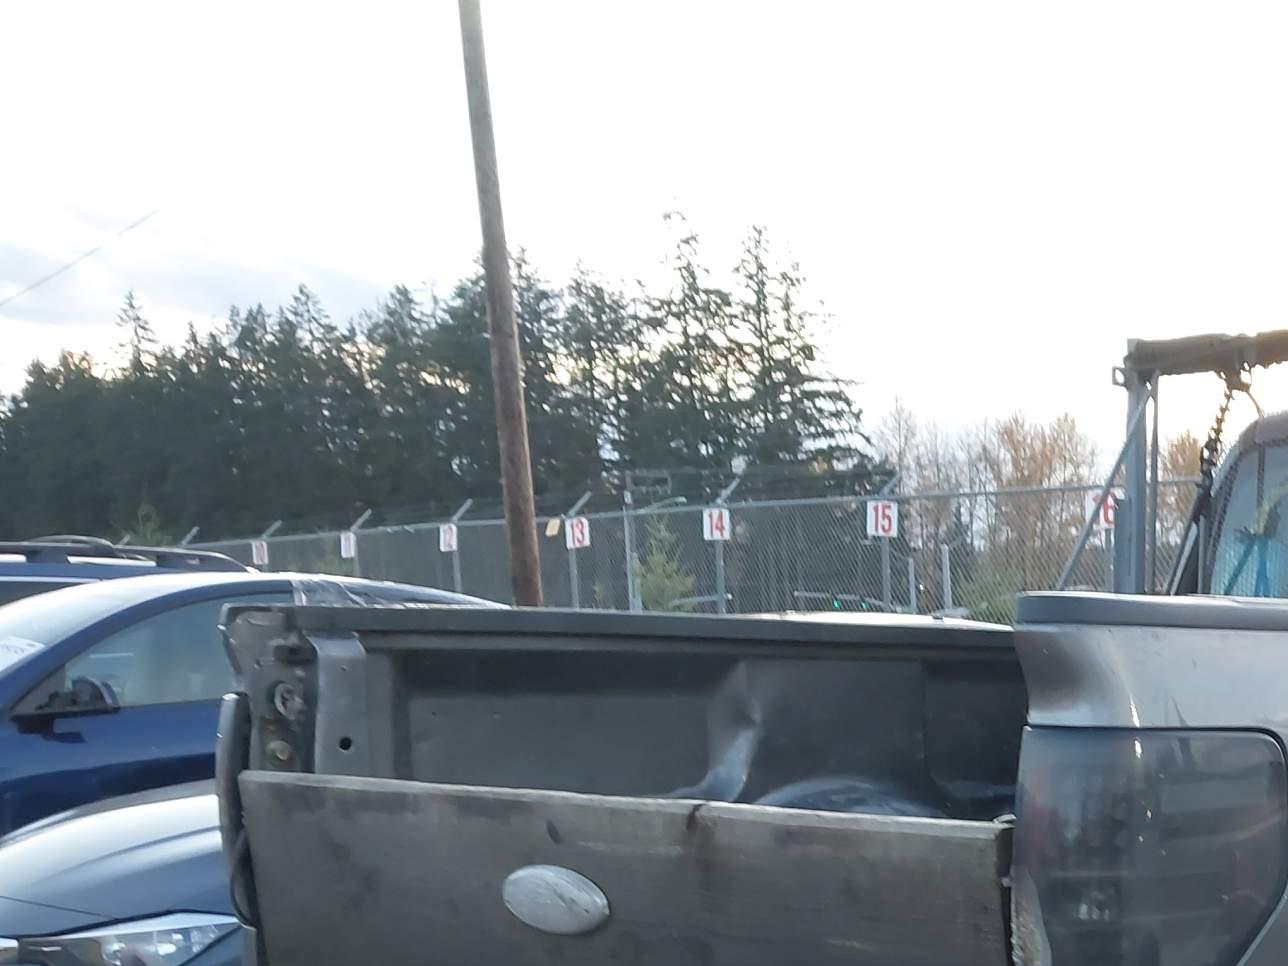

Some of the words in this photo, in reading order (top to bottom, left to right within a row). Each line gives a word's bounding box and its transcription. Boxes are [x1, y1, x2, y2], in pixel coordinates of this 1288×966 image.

[708, 511, 725, 537] 14
[873, 503, 892, 534] 15
[571, 519, 585, 545] 13
